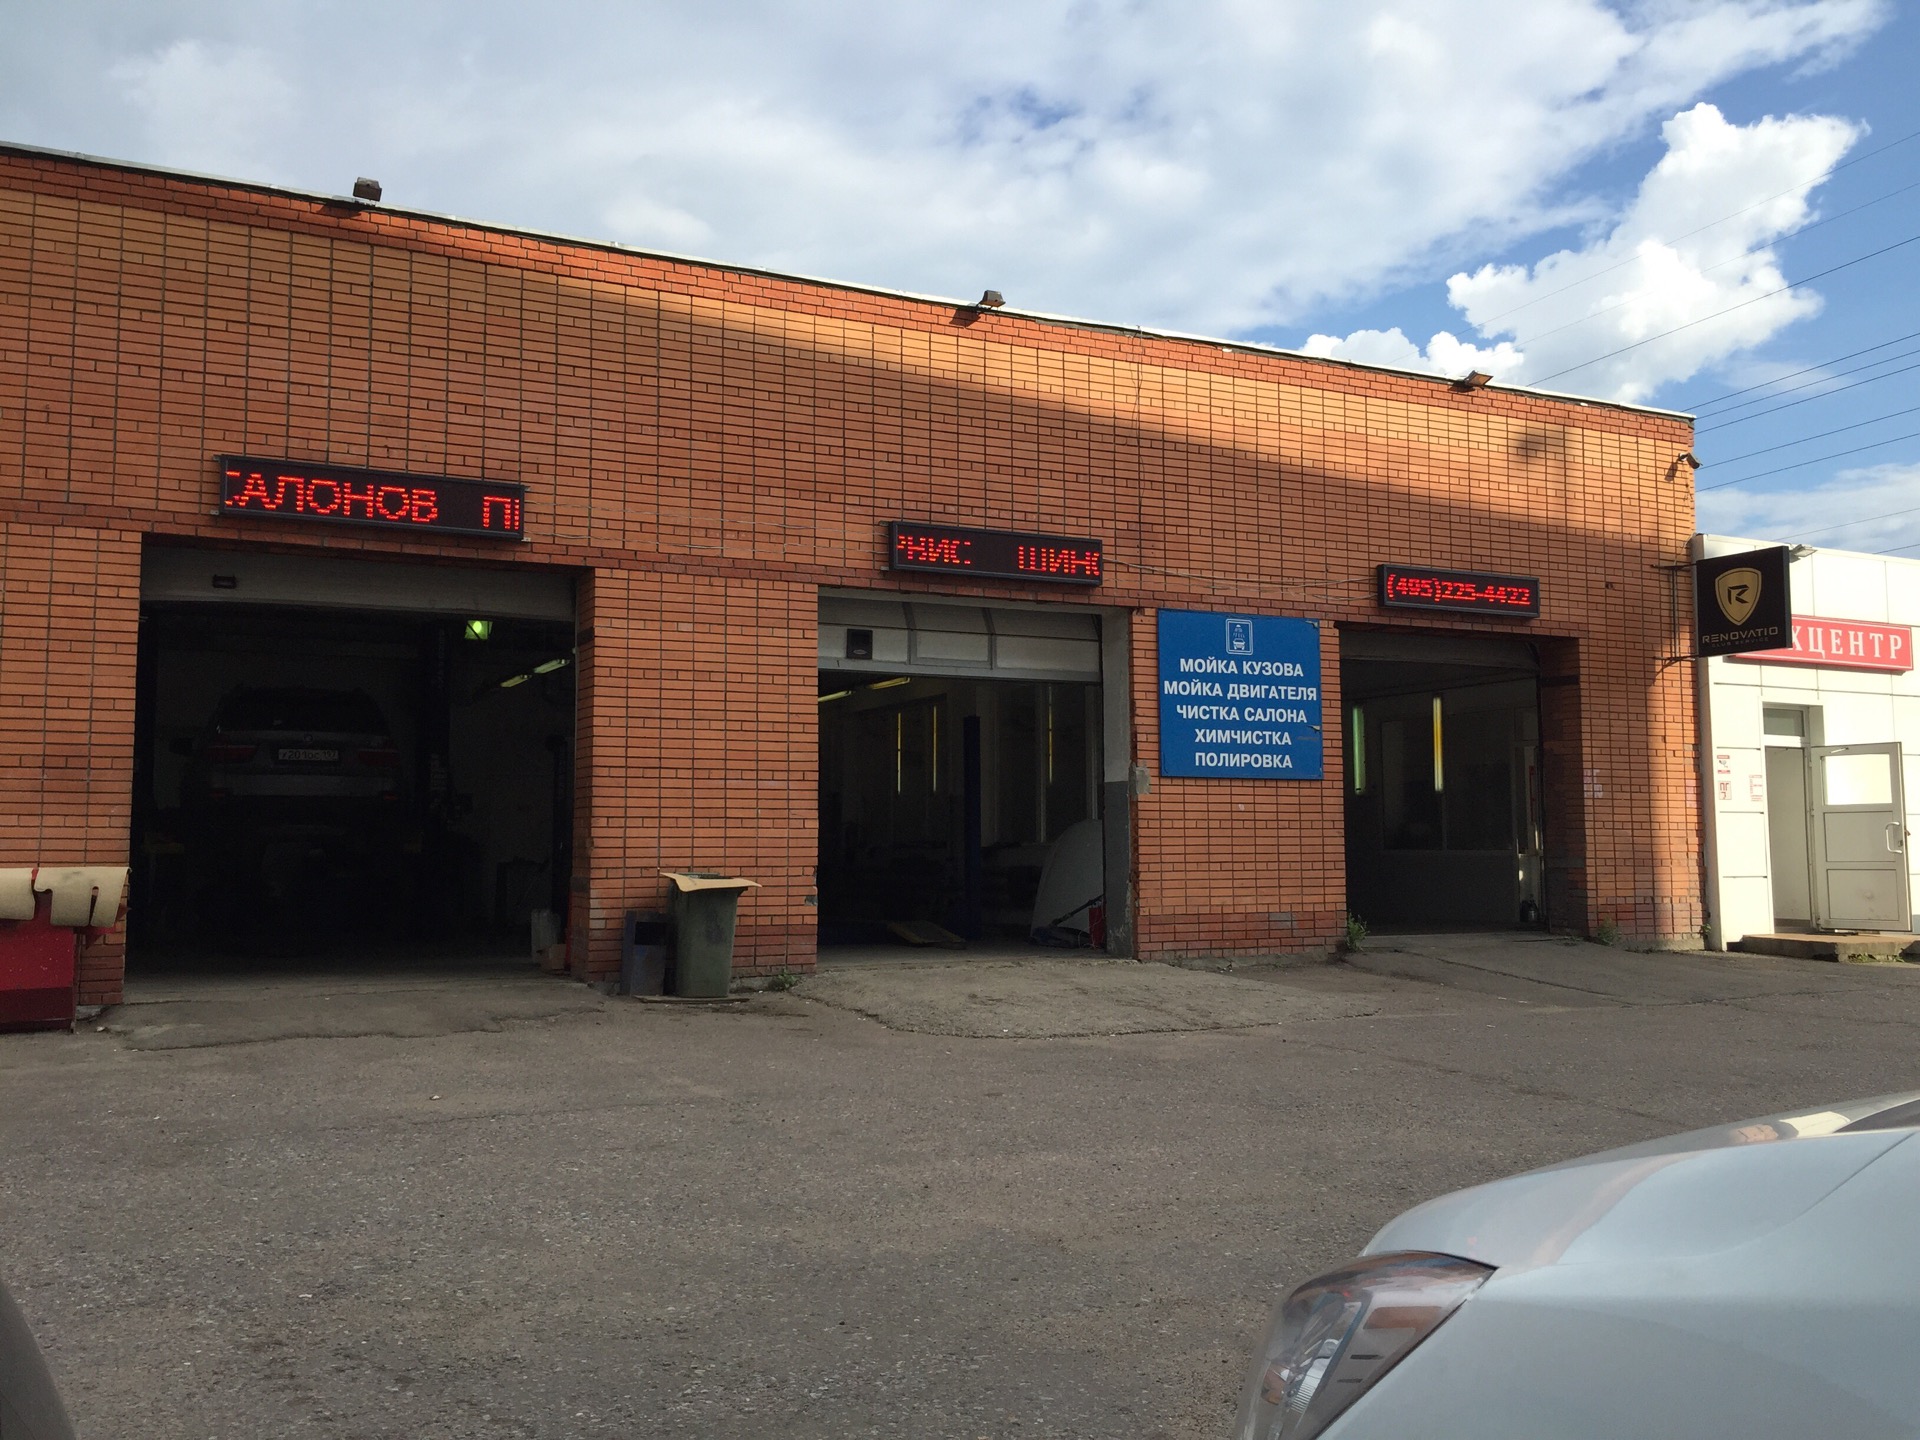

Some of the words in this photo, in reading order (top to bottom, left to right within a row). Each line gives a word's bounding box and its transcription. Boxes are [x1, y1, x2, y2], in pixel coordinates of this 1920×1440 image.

[483, 495, 521, 529] П
[1387, 573, 1531, 605] (495)225-4422
[1702, 626, 1778, 644] RENOVATIO
[1180, 656, 1238, 674] МОЙКА
[1243, 661, 1304, 677] КУЗОВА
[1164, 679, 1223, 697] МОЙКА
[1227, 683, 1317, 701] ДВИГАТЕЛЯ
[1176, 704, 1240, 721] ЧИСТКА
[1244, 707, 1307, 723] САЛОНА
[1194, 728, 1292, 746] ХИМЧИСТКА
[1195, 752, 1293, 769] ПОЛИРОВКА
